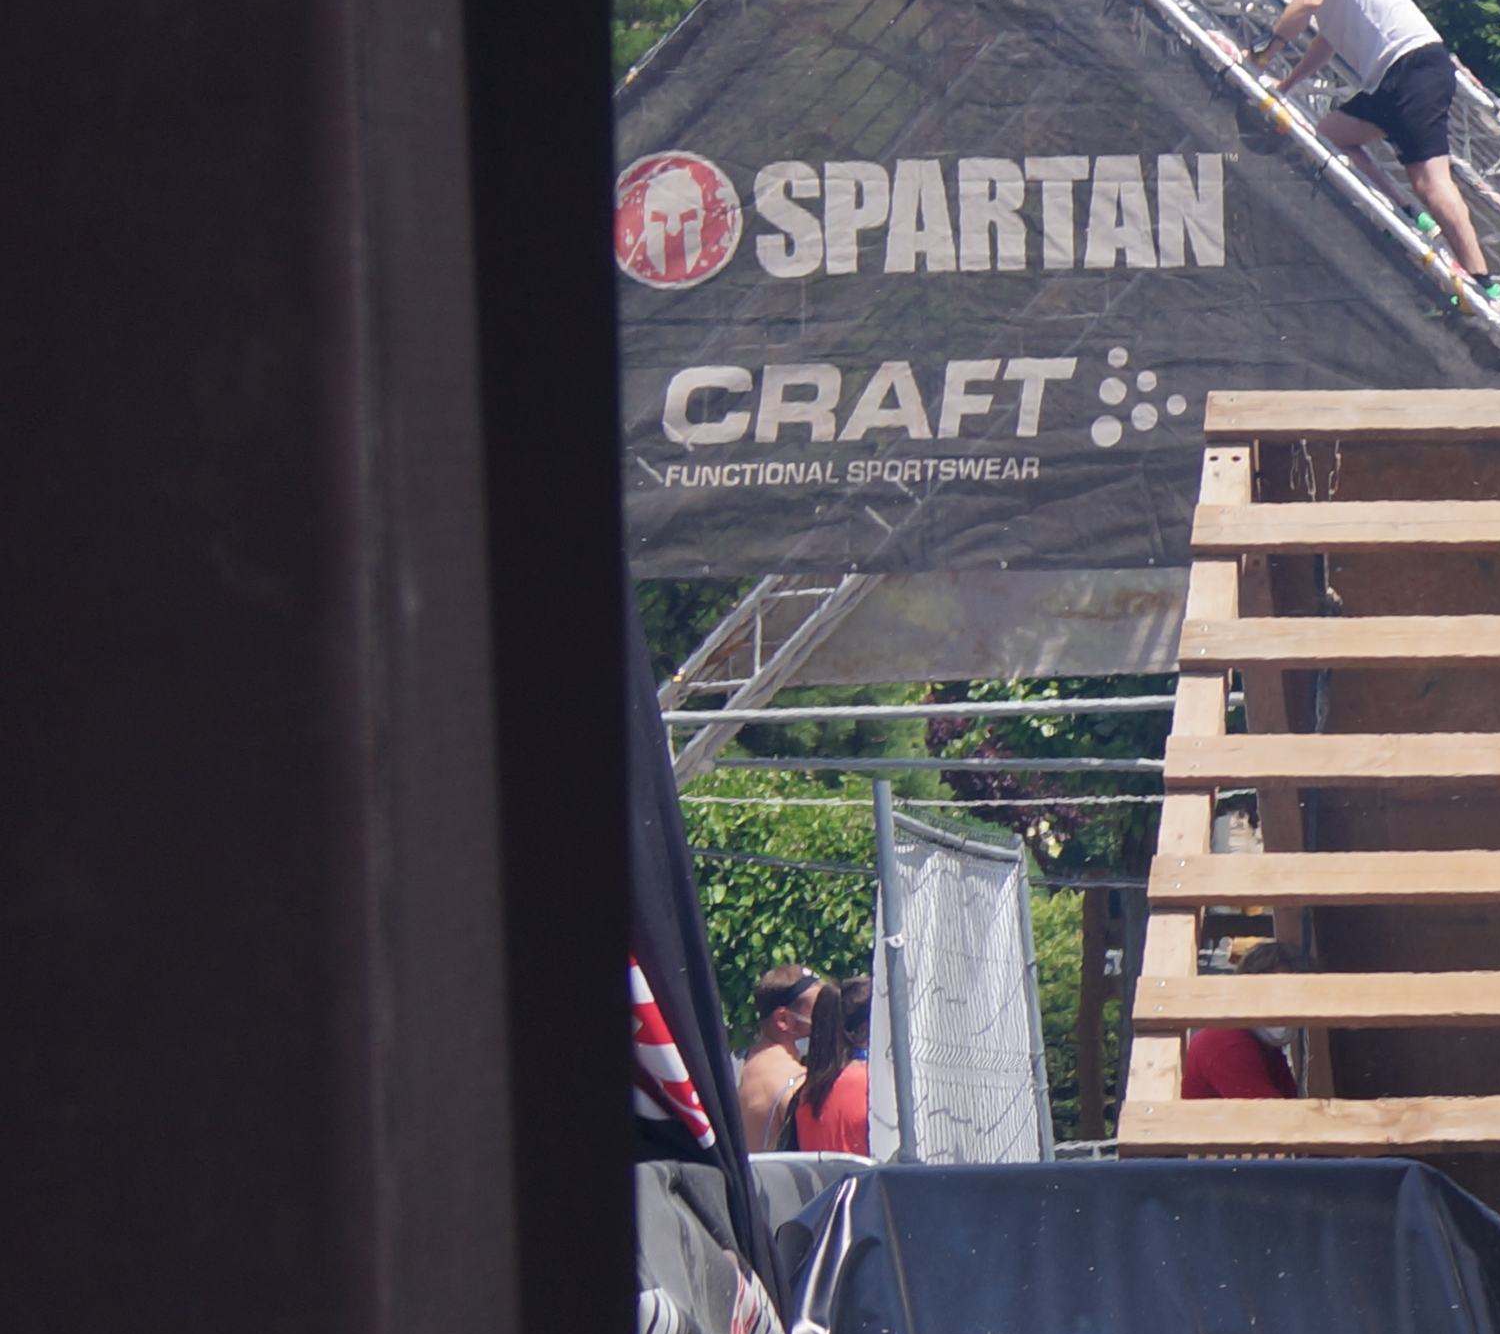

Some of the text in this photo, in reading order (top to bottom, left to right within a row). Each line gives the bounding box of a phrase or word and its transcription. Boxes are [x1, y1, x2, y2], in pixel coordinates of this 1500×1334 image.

[754, 153, 1226, 278] SPARTAN
[662, 357, 1078, 446] CRAFT
[664, 457, 1041, 488] FUNCTIONAL SPORTSWEAR
